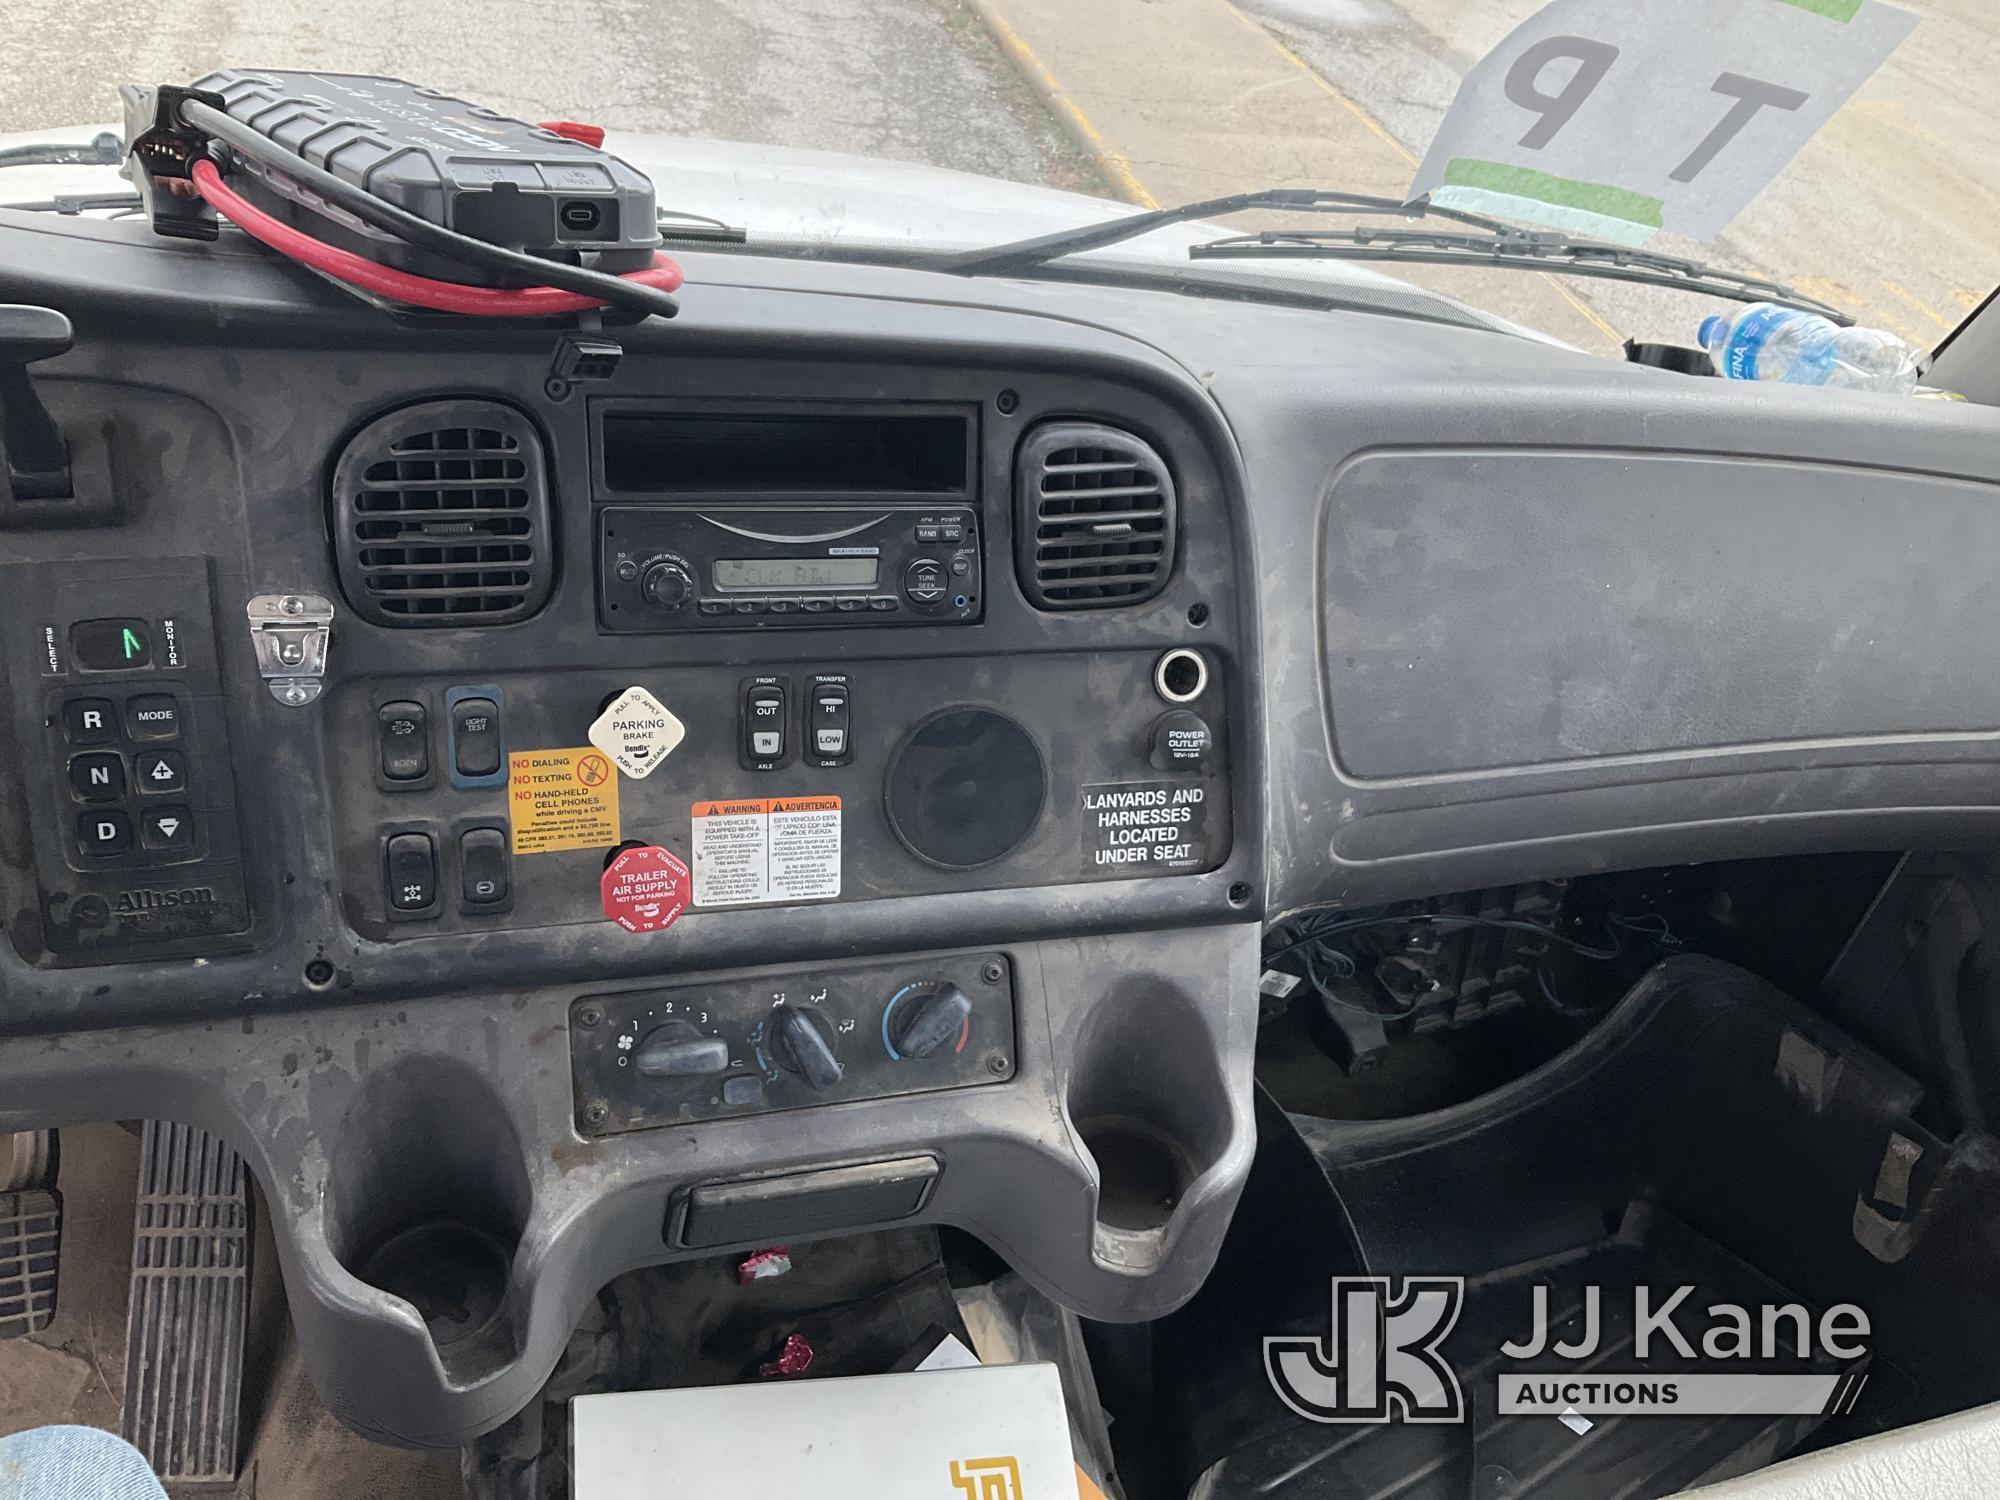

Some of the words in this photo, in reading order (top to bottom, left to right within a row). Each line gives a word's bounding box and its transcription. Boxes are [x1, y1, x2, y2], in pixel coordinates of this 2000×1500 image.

[46, 627, 58, 672] SELECT
[164, 620, 178, 665] MONITOR
[138, 710, 173, 721] MODE
[615, 701, 629, 715] PULL
[642, 700, 660, 716] APPLY
[83, 711, 102, 729] R
[613, 719, 665, 731] PARKING
[624, 732, 653, 740] BRAKE
[513, 760, 529, 768] NO
[532, 758, 570, 767] DIALING
[617, 755, 632, 769] PUSH
[645, 745, 668, 768] RELEASE
[91, 767, 109, 784] N
[514, 775, 530, 784] NO
[532, 774, 572, 783] TEXTING
[515, 791, 531, 800] NO
[535, 788, 588, 798] HAND-HELD
[1087, 790, 1166, 809] LANYARDS
[1172, 789, 1203, 803] AND
[535, 800, 559, 809] CELL
[562, 797, 599, 807] PHONES
[724, 805, 760, 814] WARNING
[786, 801, 837, 811] ADVERTENCIA
[536, 809, 555, 817] while
[557, 808, 582, 816] driving
[1098, 807, 1191, 827] HARNESSES
[98, 823, 116, 840] D
[1110, 827, 1178, 845] LOCATED
[1095, 848, 1147, 864] UNDER
[1153, 844, 1191, 860] SEAT
[614, 856, 629, 872] PULL
[657, 852, 687, 877] EVACUATE
[621, 870, 668, 884] TRAILER
[613, 885, 631, 895] AIR
[635, 879, 677, 893] SUPPLY
[115, 887, 215, 910] Allison
[647, 891, 675, 899] PARKING
[618, 916, 637, 931] PUSH
[662, 902, 682, 925] SUPPLY
[666, 1002, 673, 1013] 2
[701, 1012, 707, 1023] 3
[633, 1020, 638, 1031] 1
